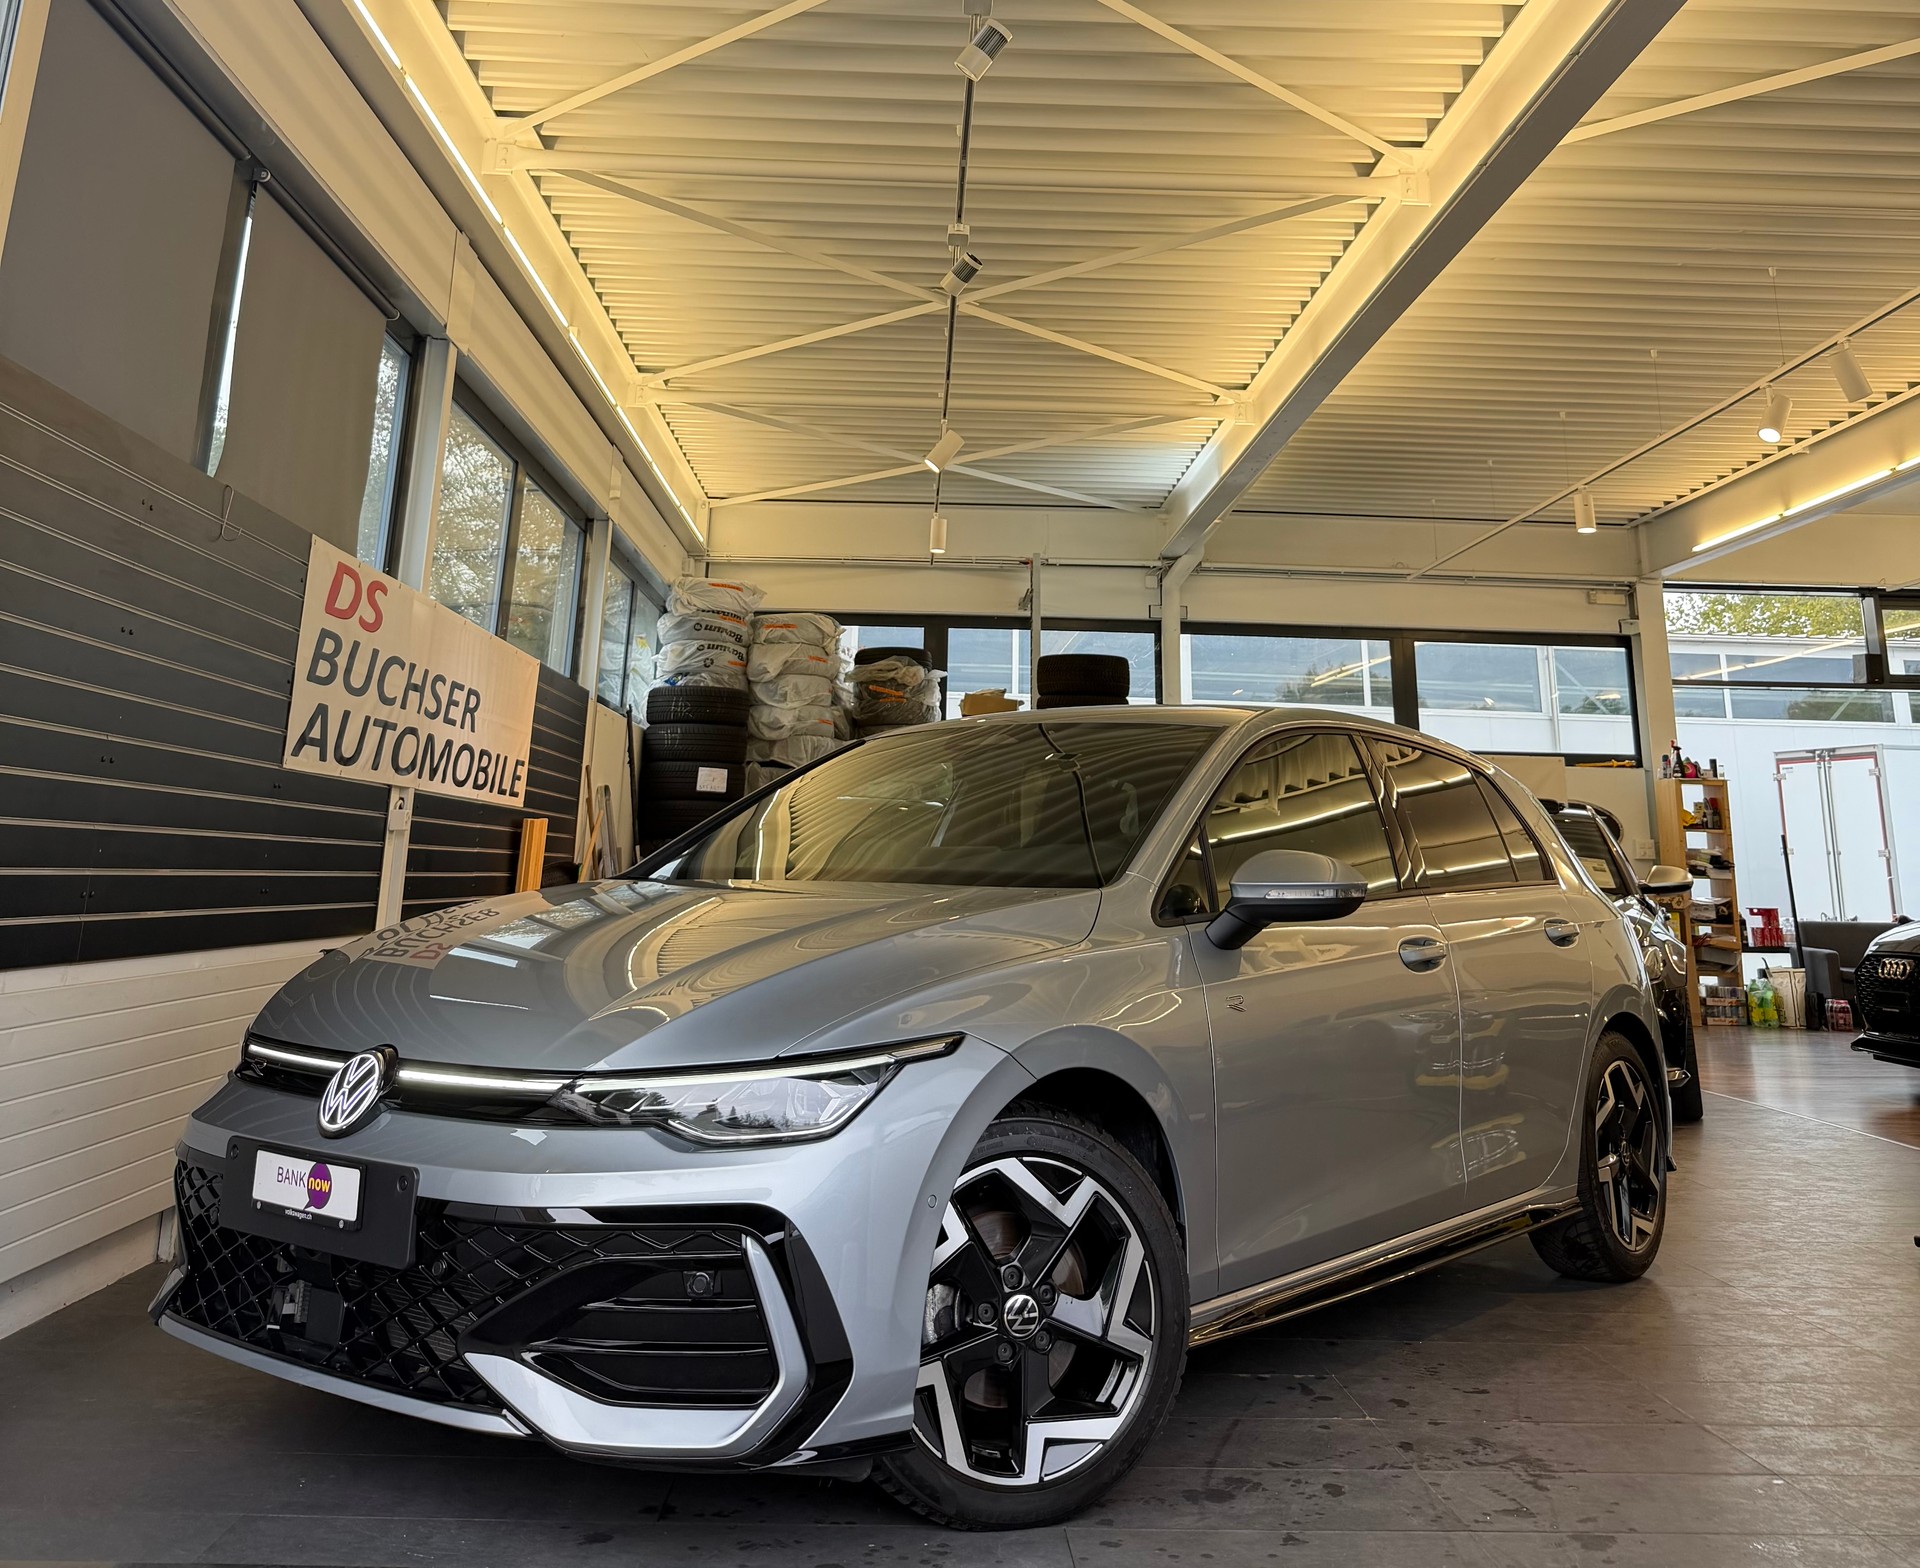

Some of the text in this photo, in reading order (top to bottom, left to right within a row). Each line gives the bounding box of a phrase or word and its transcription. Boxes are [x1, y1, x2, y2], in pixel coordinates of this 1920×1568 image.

[325, 561, 388, 633] DS
[704, 624, 743, 643] Barum
[306, 627, 481, 733] BUCHSER
[290, 703, 525, 798] AUTOMOBILE
[321, 1054, 379, 1126] VW
[276, 1166, 330, 1193] BANK now
